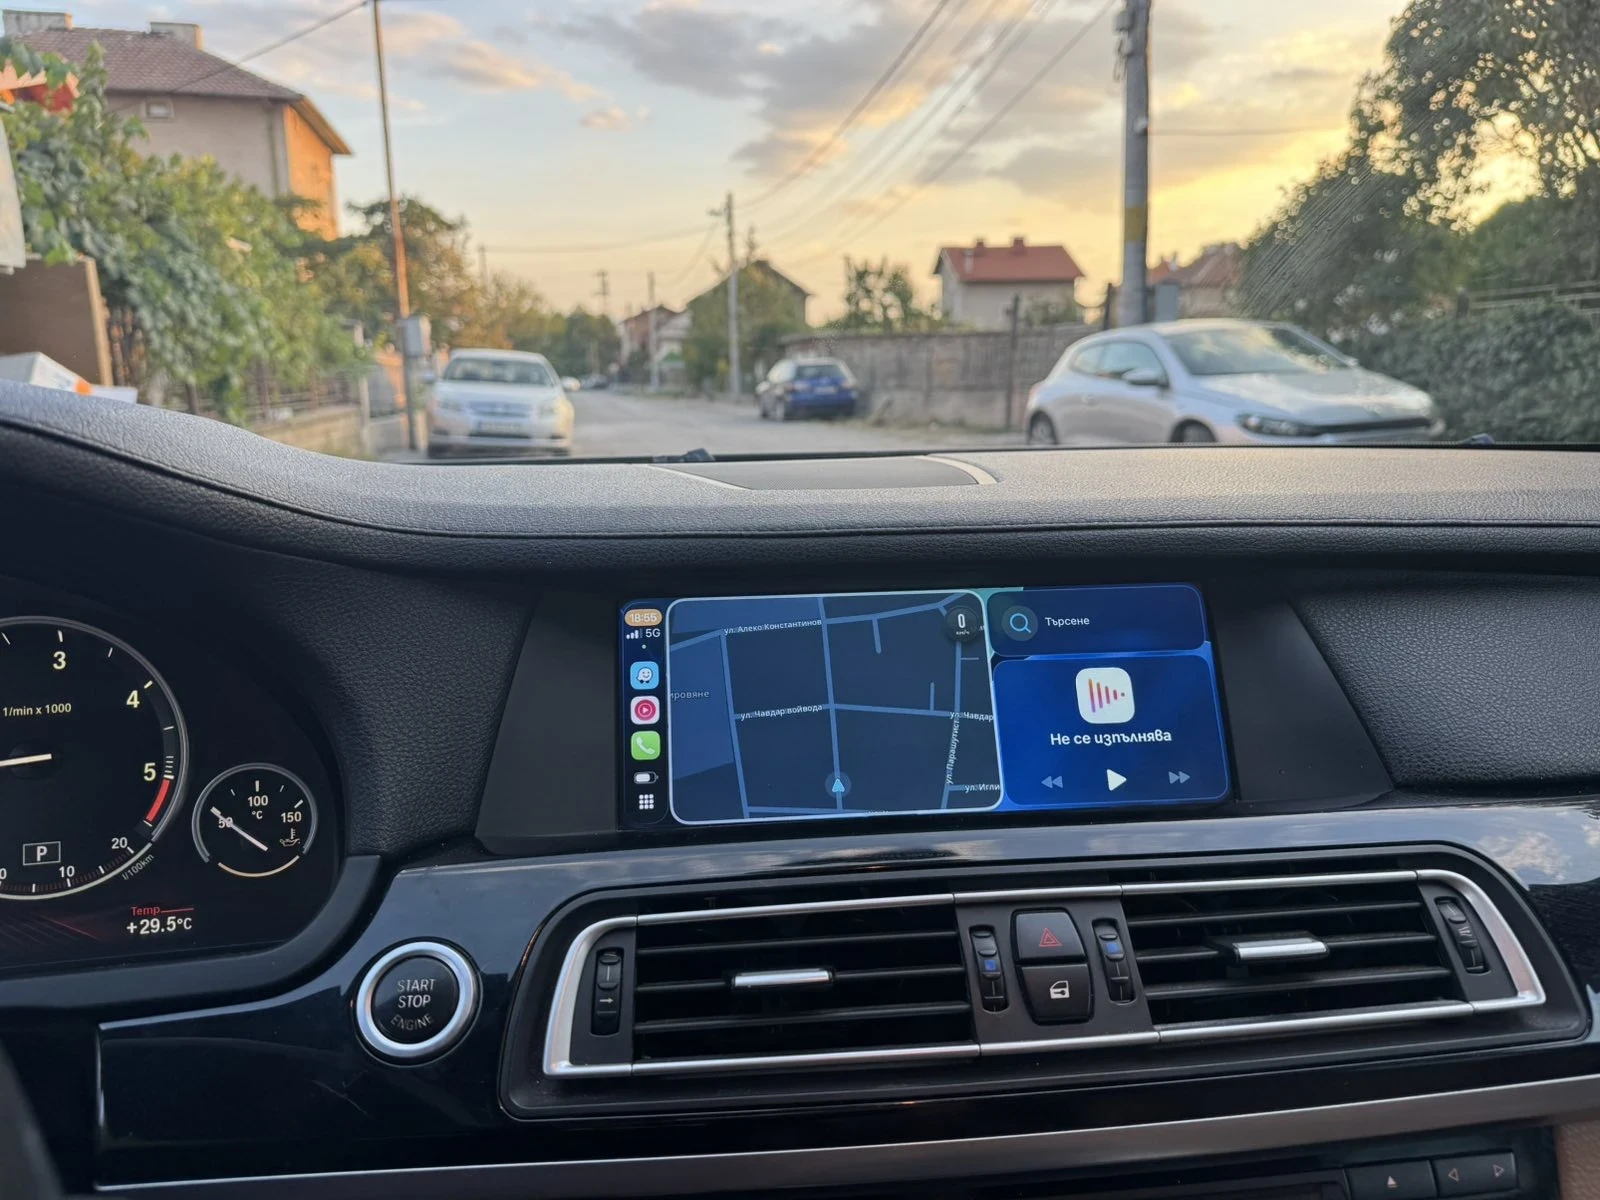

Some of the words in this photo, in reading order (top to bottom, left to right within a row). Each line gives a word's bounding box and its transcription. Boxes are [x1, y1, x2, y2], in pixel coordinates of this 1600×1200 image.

[629, 613, 658, 623] 18:55
[957, 613, 966, 629] 0
[1044, 616, 1090, 628] Търсене
[645, 628, 661, 638] 5G
[738, 625, 762, 633] Алеко
[764, 619, 822, 630] Константинов
[52, 650, 67, 670] 3
[125, 689, 140, 709] 4
[2, 705, 34, 717] 1/min
[45, 702, 72, 714] 1000
[754, 706, 786, 717] Чавдар
[787, 703, 823, 714] войвода
[1050, 733, 1071, 746] Не
[1073, 734, 1091, 745] се
[1094, 729, 1172, 747] изпълнява
[143, 762, 157, 782] 5
[247, 795, 269, 807] 100
[280, 811, 302, 823] 150
[111, 836, 128, 850] 20
[36, 845, 48, 862] P
[58, 865, 75, 878] 10
[131, 906, 161, 917] Temp
[397, 979, 436, 993] START
[398, 994, 431, 1009] STOP
[390, 1012, 433, 1031] ENGINE
